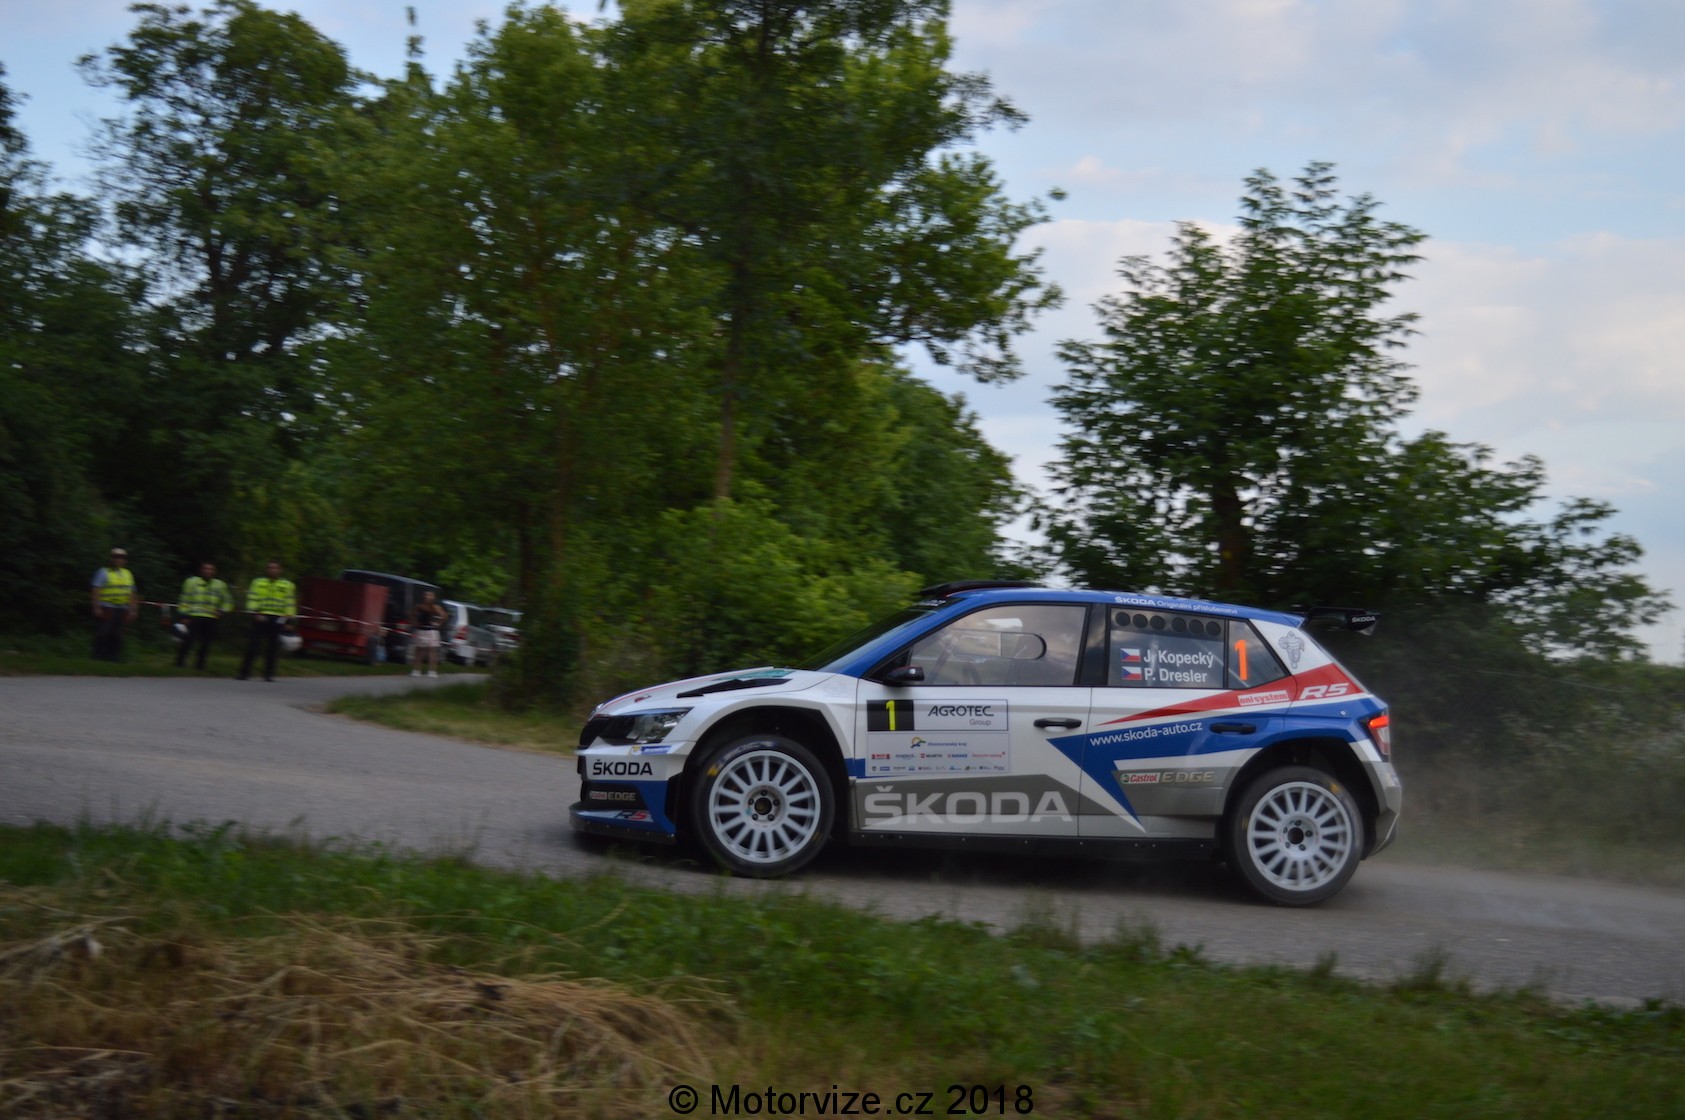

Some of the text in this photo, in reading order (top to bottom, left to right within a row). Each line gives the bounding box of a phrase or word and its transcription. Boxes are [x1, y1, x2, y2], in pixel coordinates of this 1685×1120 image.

[1114, 596, 1155, 606] ŠKODA
[1158, 650, 1214, 668] Kopecký
[1234, 639, 1248, 680] 1
[1144, 667, 1207, 682] P. Dresler
[1299, 682, 1349, 700] R5
[885, 700, 896, 731] 1
[927, 705, 994, 717] AGROTEC
[969, 718, 992, 726] Group
[1089, 722, 1203, 746] www.skoda-auto.cz
[593, 759, 653, 776] ŠKODA
[1130, 771, 1216, 783] Castrol EDGE
[607, 791, 636, 801] EDGE
[864, 785, 1073, 824] ŠKODA
